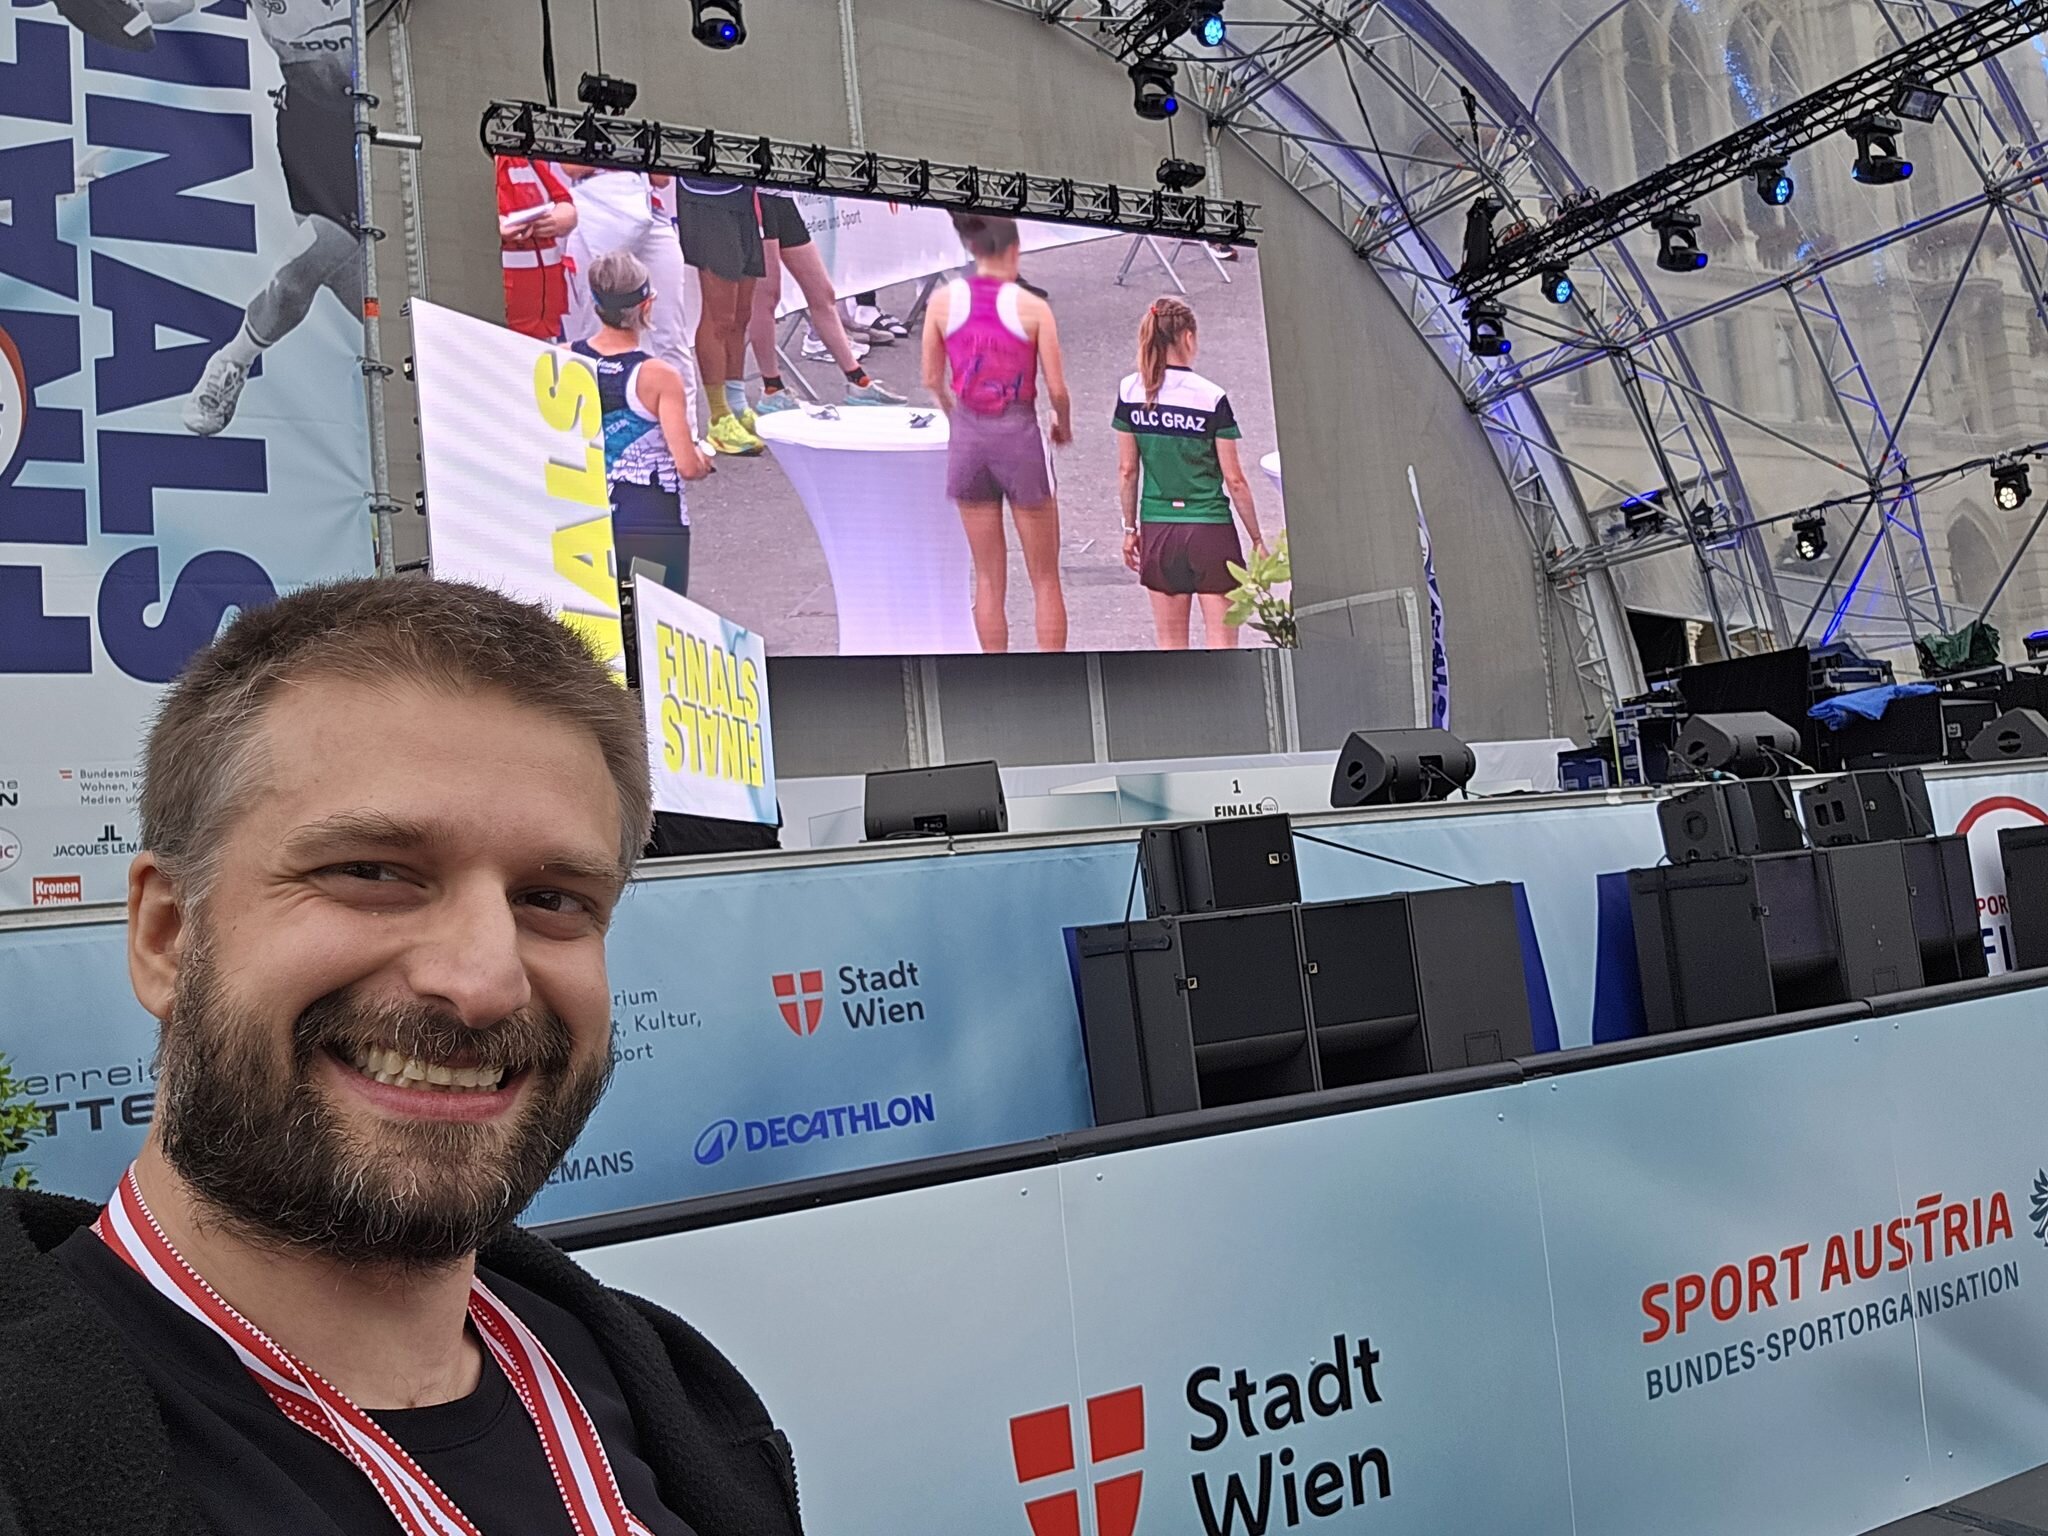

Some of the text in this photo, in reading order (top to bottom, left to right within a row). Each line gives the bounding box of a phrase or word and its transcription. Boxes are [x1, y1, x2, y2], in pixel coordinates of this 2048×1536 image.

[841, 209, 862, 230] Sport
[83, 0, 279, 683] INALS
[1131, 410, 1206, 432] OLC GRAZ
[656, 620, 760, 724] FINALS
[80, 769, 141, 779] Bundesmin
[1232, 779, 1242, 794] 1
[81, 794, 121, 805] Medien
[1214, 803, 1262, 817] FINALS
[53, 842, 141, 857] JACQUES LEM
[35, 881, 79, 895] Kronen
[1976, 894, 2009, 916] POR
[838, 960, 920, 995] Stadt
[613, 989, 658, 1007] rium
[635, 1010, 702, 1032] Kultur,
[842, 997, 925, 1029] Wien
[612, 1043, 654, 1063] port
[22, 1057, 156, 1096] errei
[33, 1092, 157, 1137] TTE
[744, 1093, 935, 1152] DECATHLON
[1642, 1192, 2014, 1344] SPORT AUSTRIA
[1645, 1260, 2020, 1400] BUNDES-SPORTORGANISATION
[1186, 1333, 1383, 1452] Stadt
[1191, 1447, 1392, 1536] Wien
